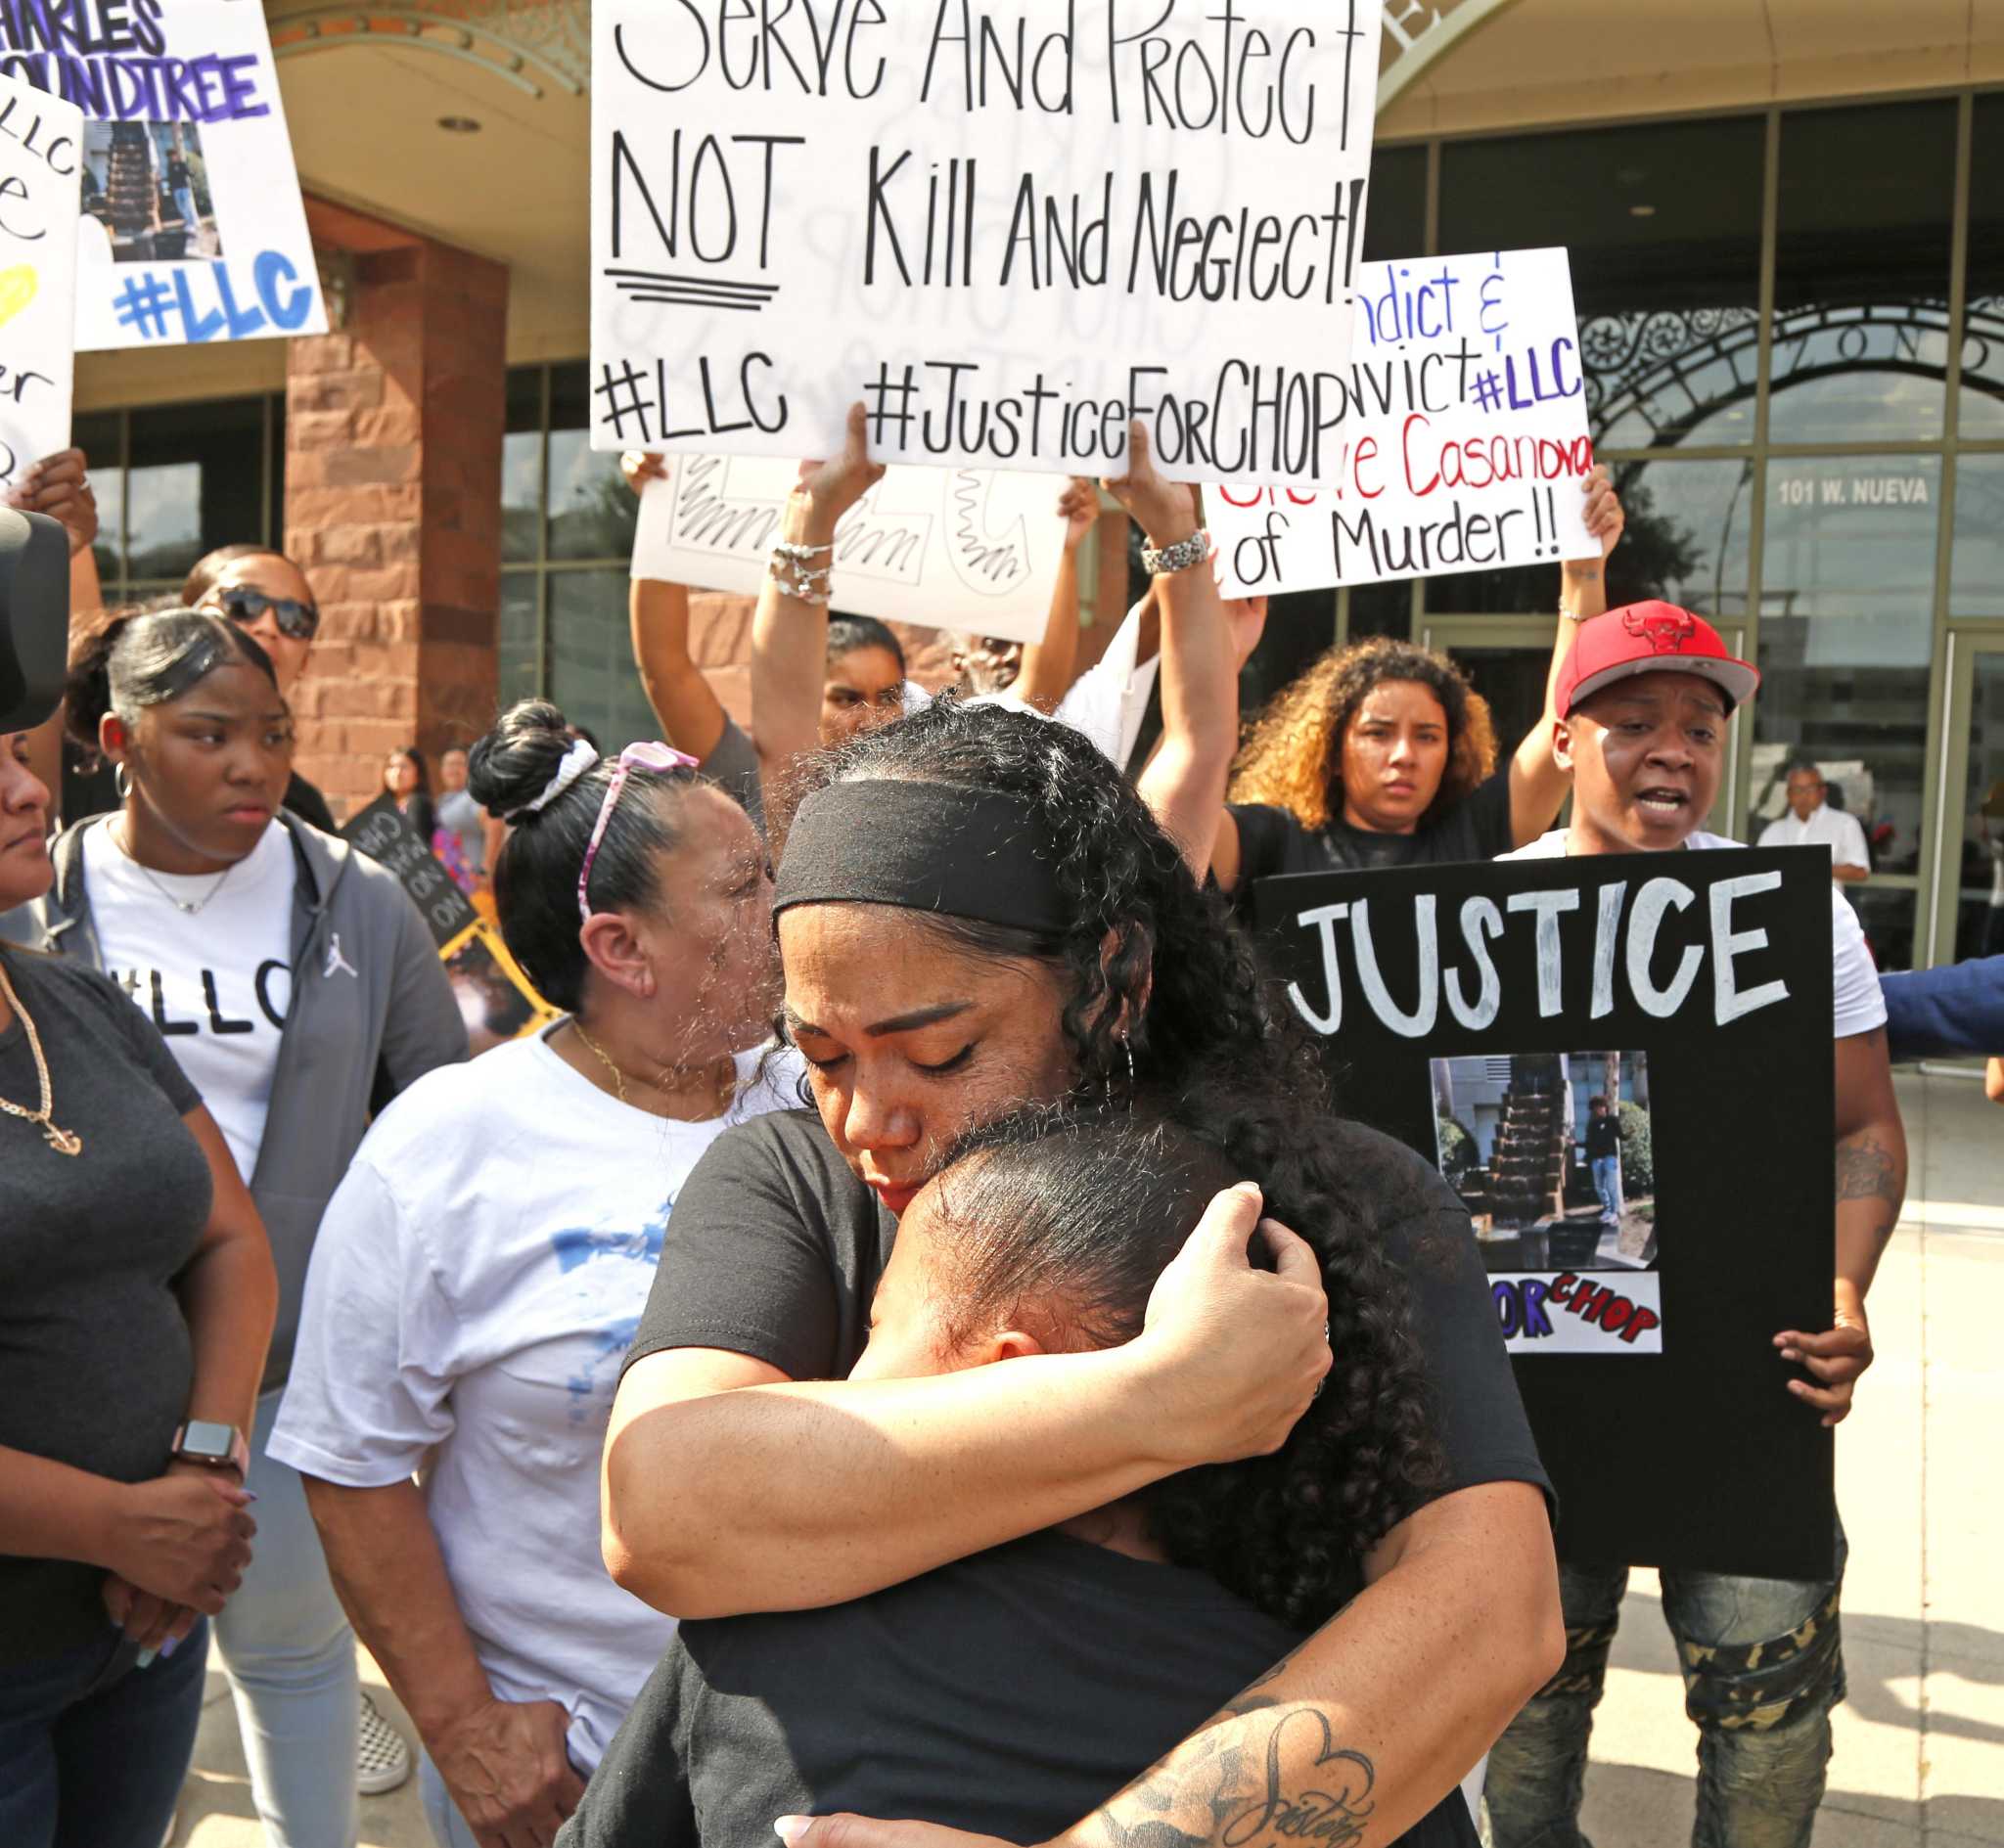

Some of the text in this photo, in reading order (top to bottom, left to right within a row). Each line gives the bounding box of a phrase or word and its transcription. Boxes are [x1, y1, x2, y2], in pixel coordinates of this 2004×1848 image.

[613, 129, 805, 269] NOT
[864, 146, 976, 287] Kill
[113, 250, 312, 342] #LLC
[594, 352, 789, 443] #LLC
[1469, 337, 1583, 414] #LLC
[1402, 413, 1595, 497] Casanova
[1779, 477, 1929, 505] 101 W. NUEVA
[1234, 486, 1561, 585] of Murder!!
[1288, 871, 1790, 1038] JUSTICE
[1548, 1272, 1661, 1344] CHOP
